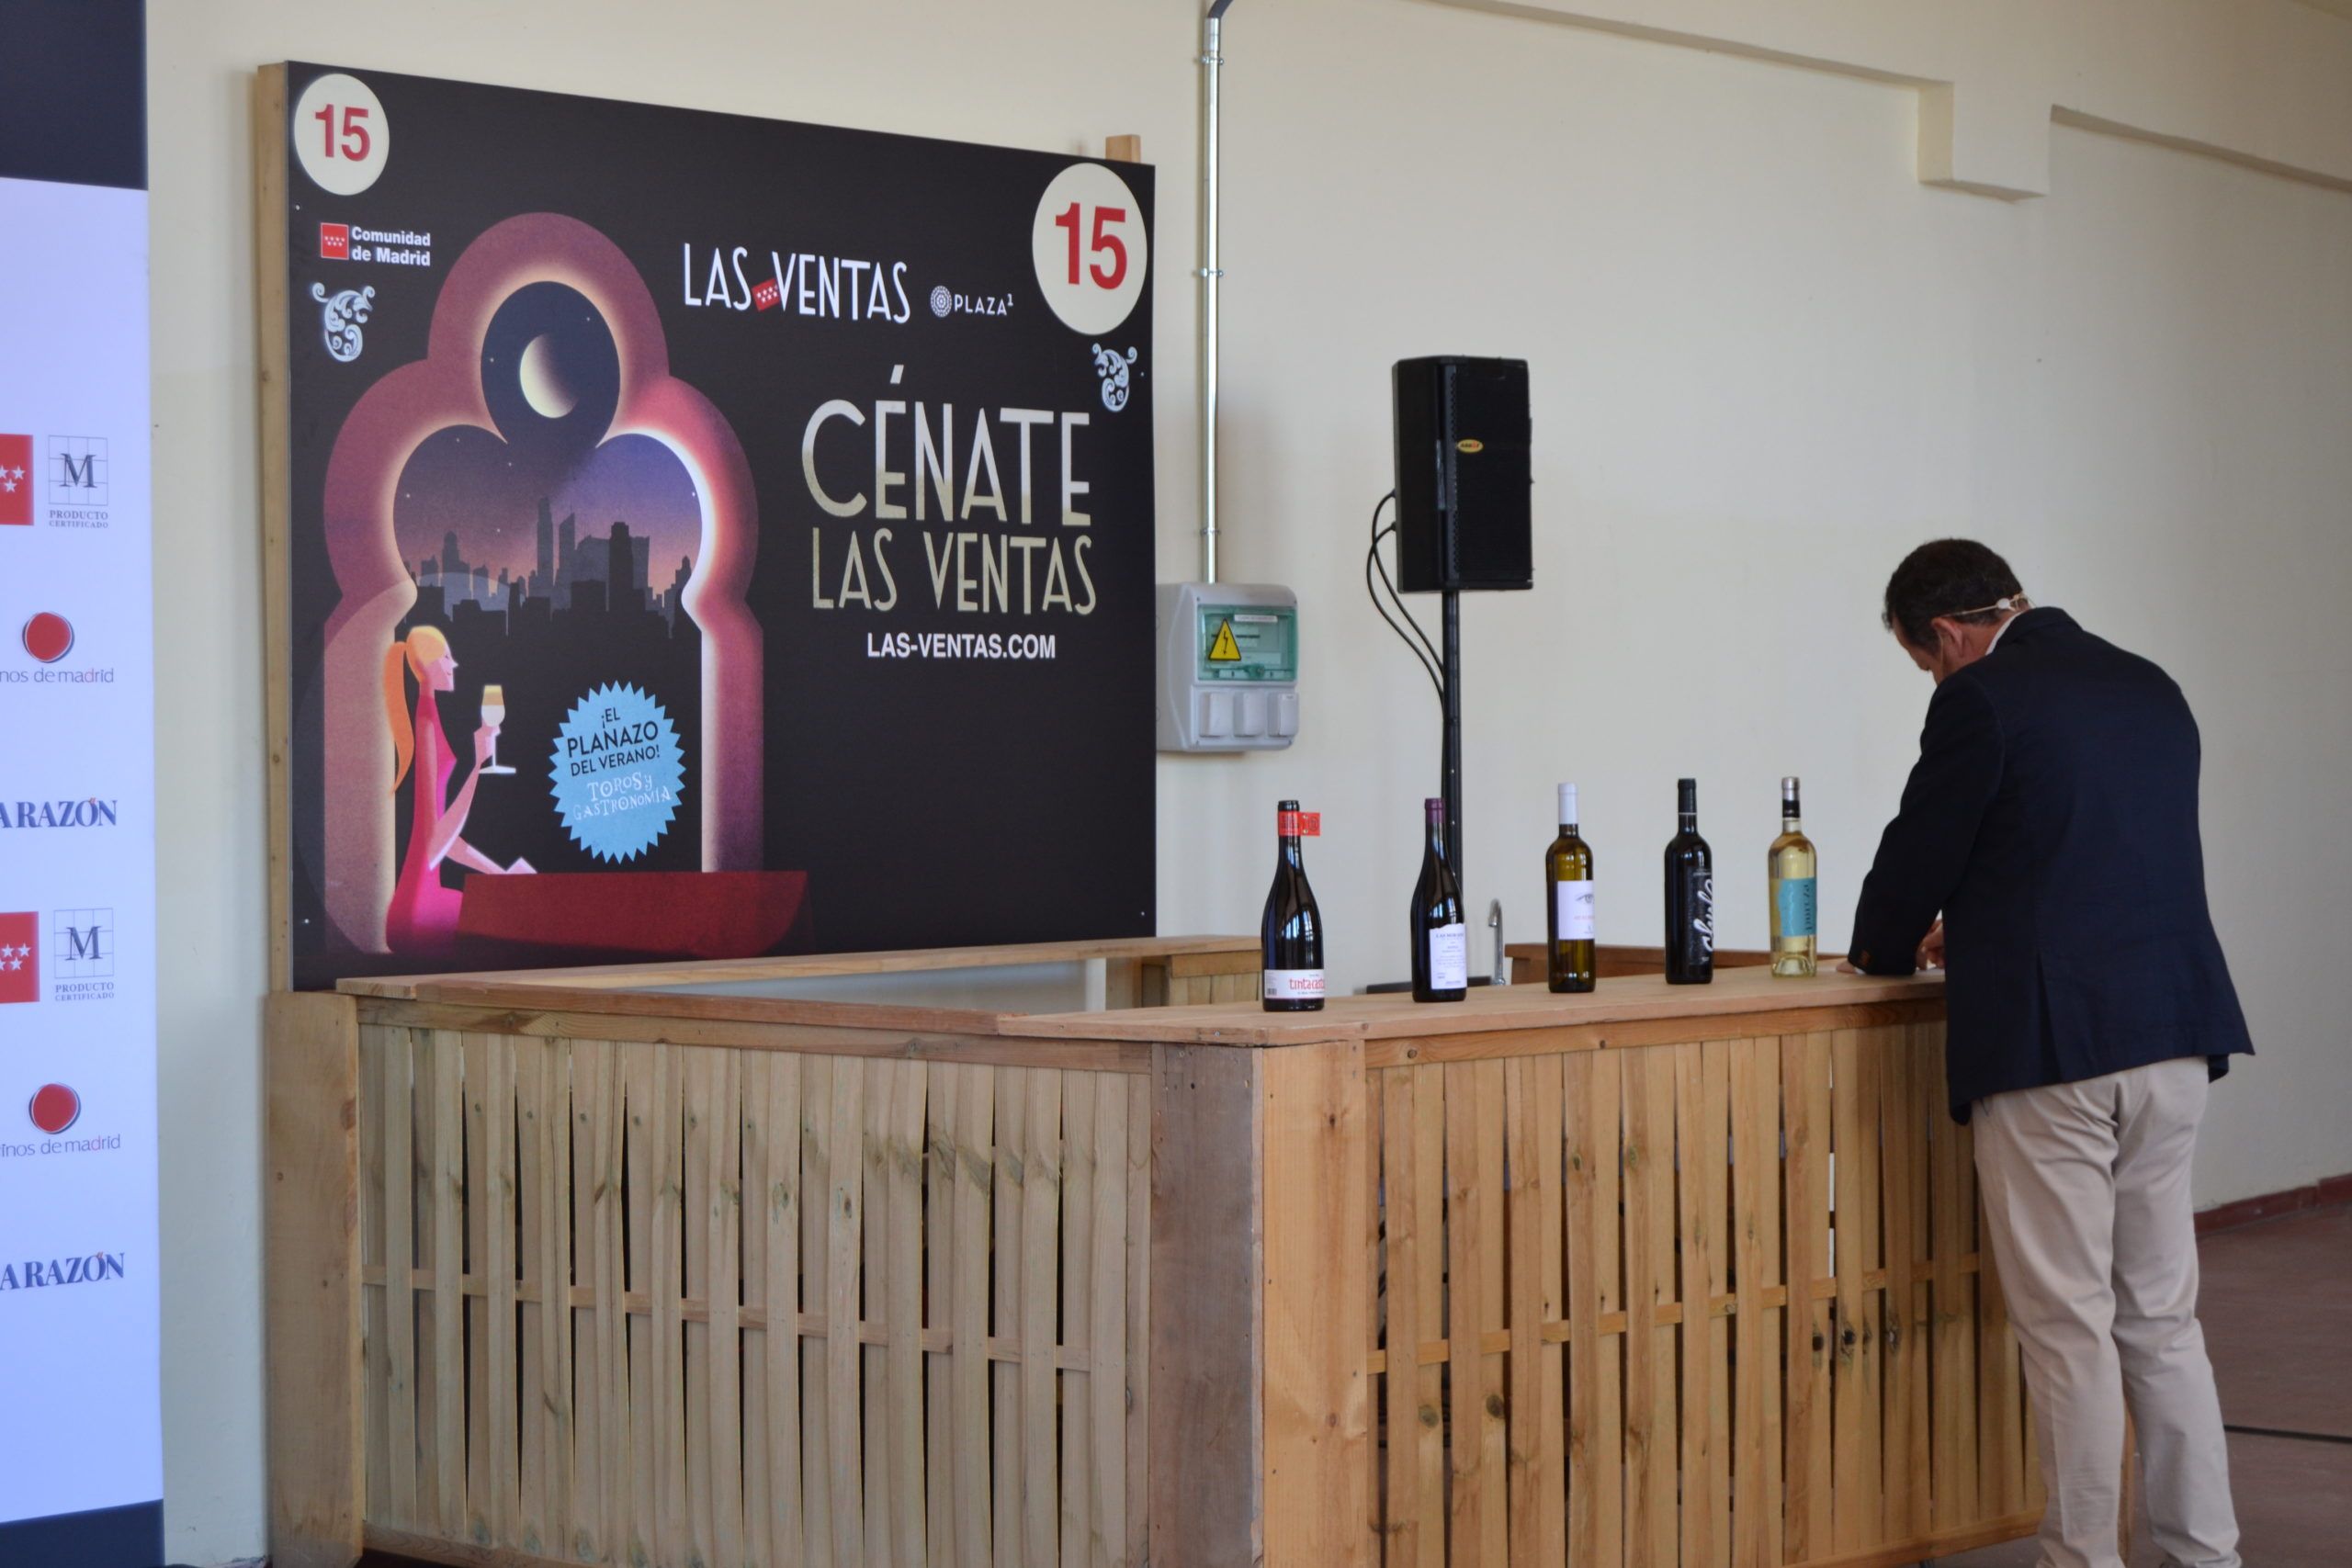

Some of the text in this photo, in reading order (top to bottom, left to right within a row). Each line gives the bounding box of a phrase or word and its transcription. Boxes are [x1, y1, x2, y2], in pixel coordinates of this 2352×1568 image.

[314, 104, 370, 162] 15
[351, 226, 431, 247] Comunidad
[1055, 201, 1128, 290] 15
[351, 245, 431, 266] de Madrid
[684, 243, 911, 324] LAS VENTAS
[801, 364, 1091, 526] CÉNATE
[49, 510, 108, 521] PRODUCTO
[49, 520, 108, 529] CERTIFICADO
[812, 527, 1097, 615] LAS VENTAS
[866, 632, 1057, 660] LAS-VENTAS.COM
[0, 671, 28, 683] nos
[567, 720, 659, 759] PLANAZO
[571, 744, 661, 777] DEL VERANO!
[55, 982, 115, 993] PRODUCTO
[55, 992, 115, 1002] CERTIFICADO
[0, 1143, 36, 1157] inos
